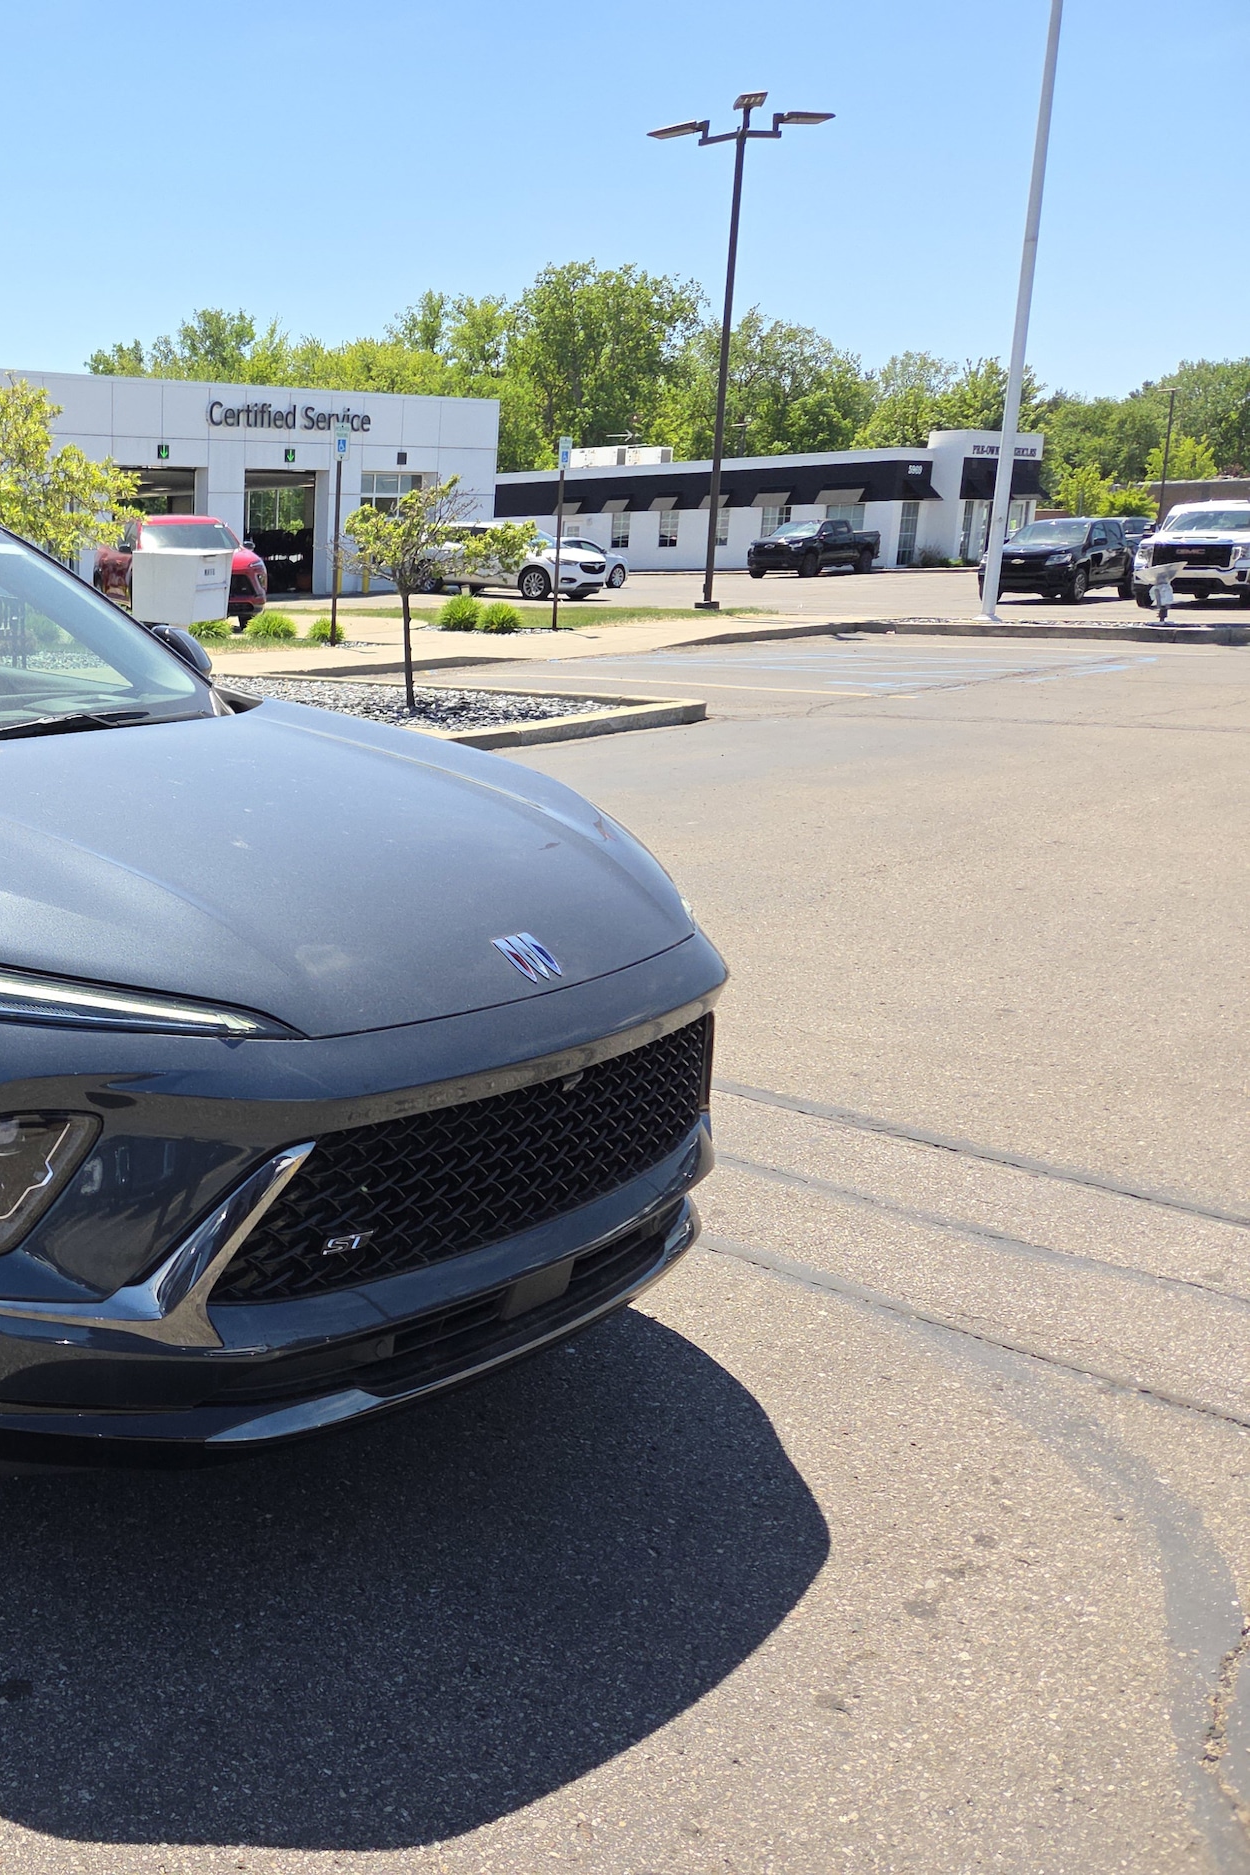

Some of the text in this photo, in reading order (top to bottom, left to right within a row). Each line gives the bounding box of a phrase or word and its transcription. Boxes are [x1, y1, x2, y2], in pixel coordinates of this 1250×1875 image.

[208, 400, 297, 430] Certified
[303, 406, 371, 432] Service
[322, 1229, 374, 1256] ST
